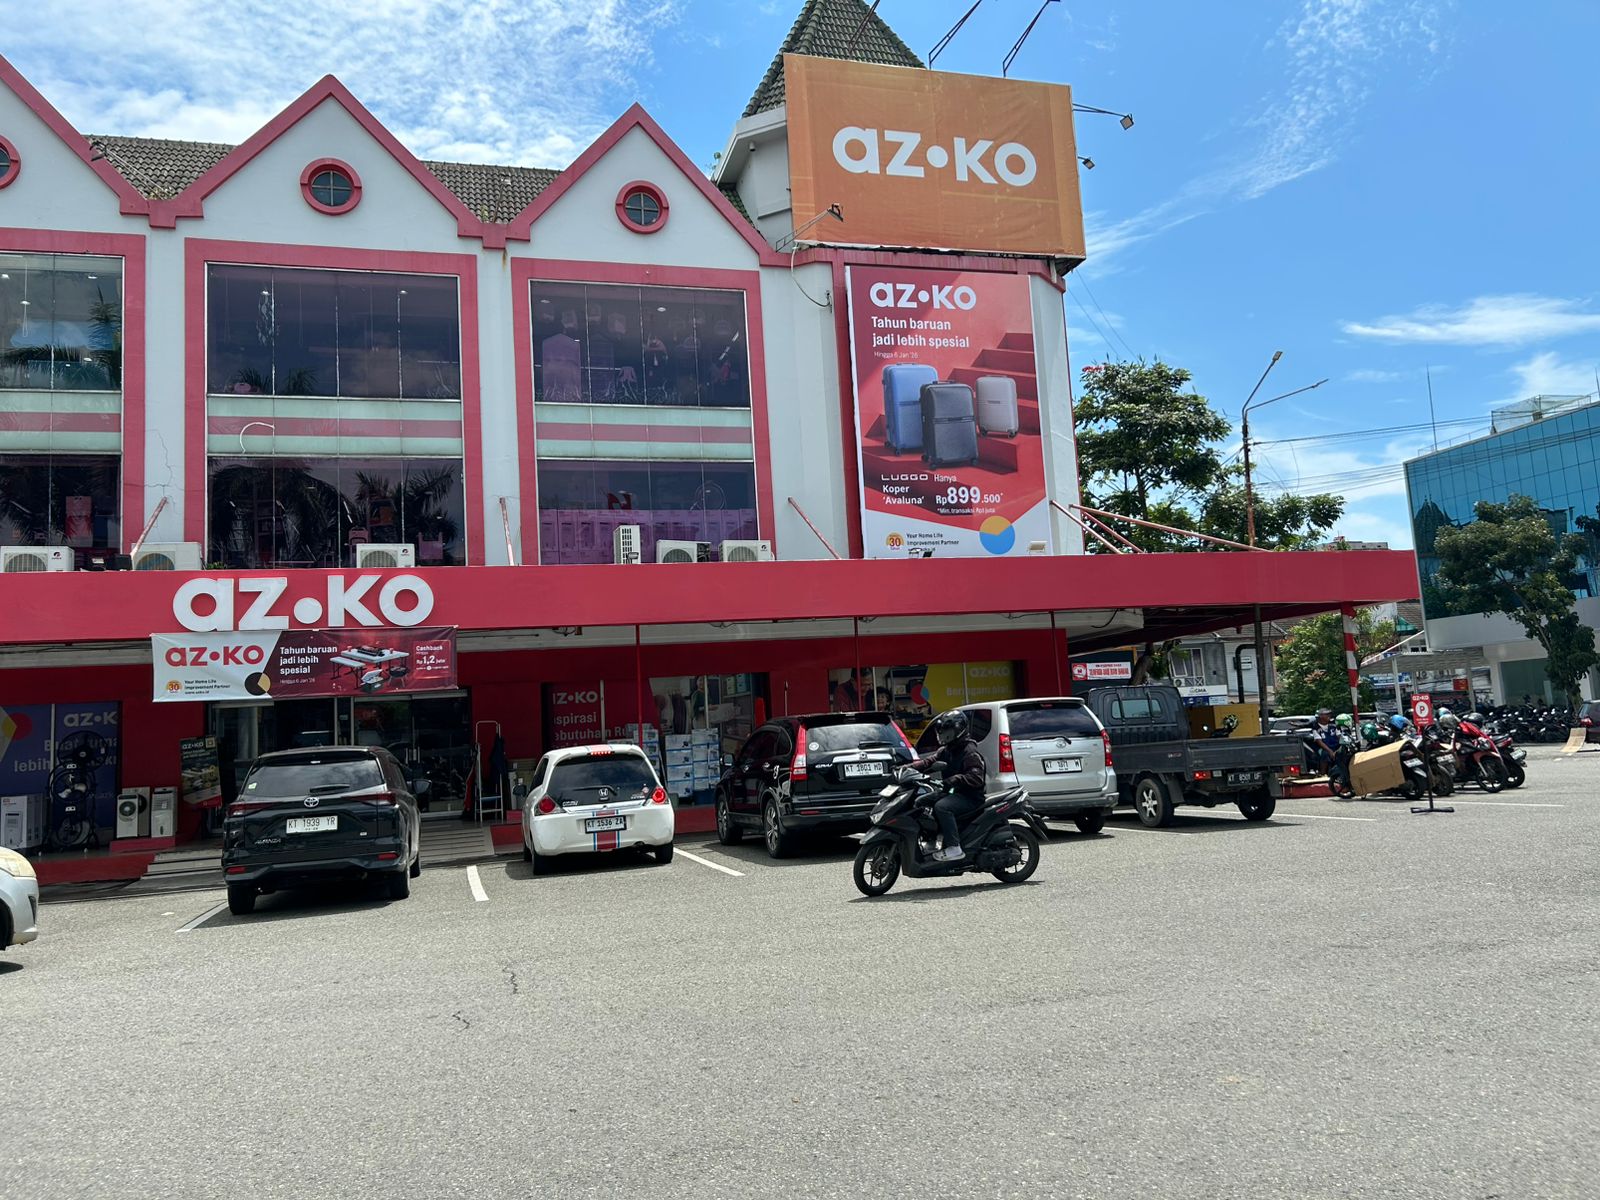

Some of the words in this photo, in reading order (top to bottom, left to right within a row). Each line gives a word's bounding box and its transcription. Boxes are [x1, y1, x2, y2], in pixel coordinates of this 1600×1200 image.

[871, 316, 907, 329] Tahun
[909, 318, 951, 330] baruan
[872, 333, 895, 347] jadi
[897, 334, 926, 346] lebih
[928, 336, 969, 349] spesial
[934, 474, 957, 483] Hanya
[882, 485, 910, 495] Koper
[889, 537, 902, 547] 30
[280, 646, 306, 655] Tahun
[280, 656, 296, 666] jadi
[298, 655, 319, 663] lebih
[280, 665, 311, 675] spesial
[168, 683, 180, 691] 30
[289, 820, 297, 828] KT
[303, 818, 320, 827] 1939
[327, 816, 335, 825] YR
[587, 820, 595, 828] KT
[597, 818, 612, 827] 1536
